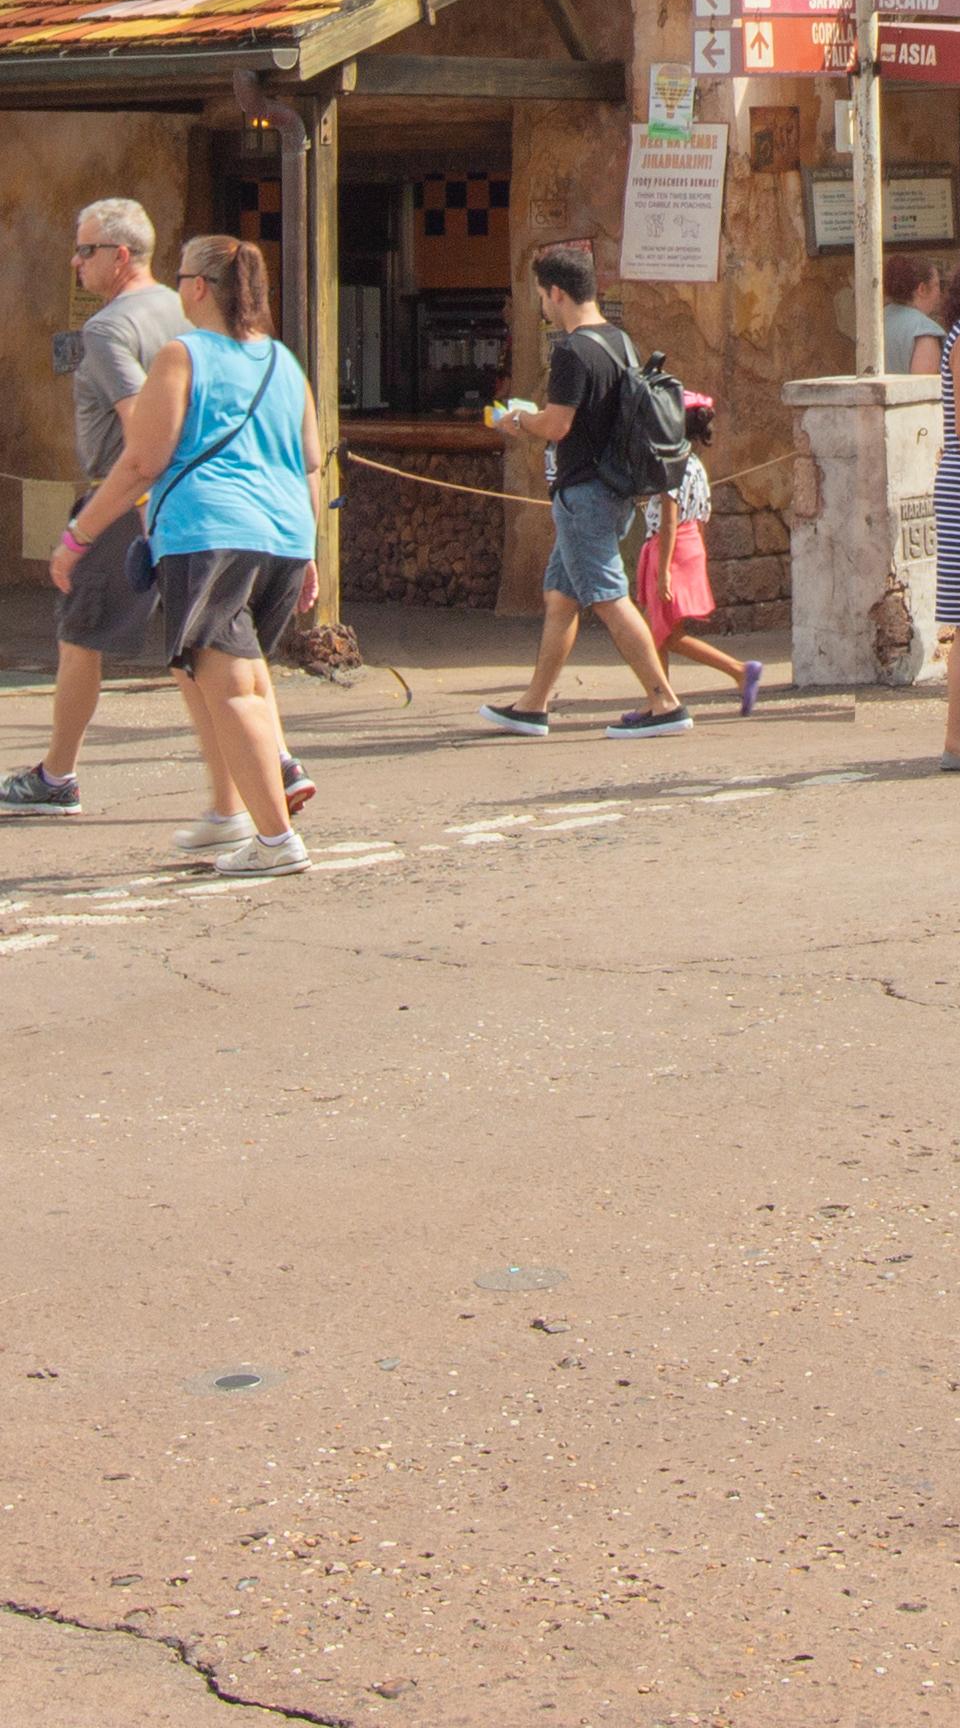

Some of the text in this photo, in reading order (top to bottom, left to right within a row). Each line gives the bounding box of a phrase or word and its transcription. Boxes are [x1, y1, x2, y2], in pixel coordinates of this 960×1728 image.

[812, 21, 855, 45] GORILLA
[824, 46, 856, 68] FALLS
[898, 43, 937, 67] ASIA
[901, 500, 936, 521] HARAM
[901, 523, 937, 560] 196
